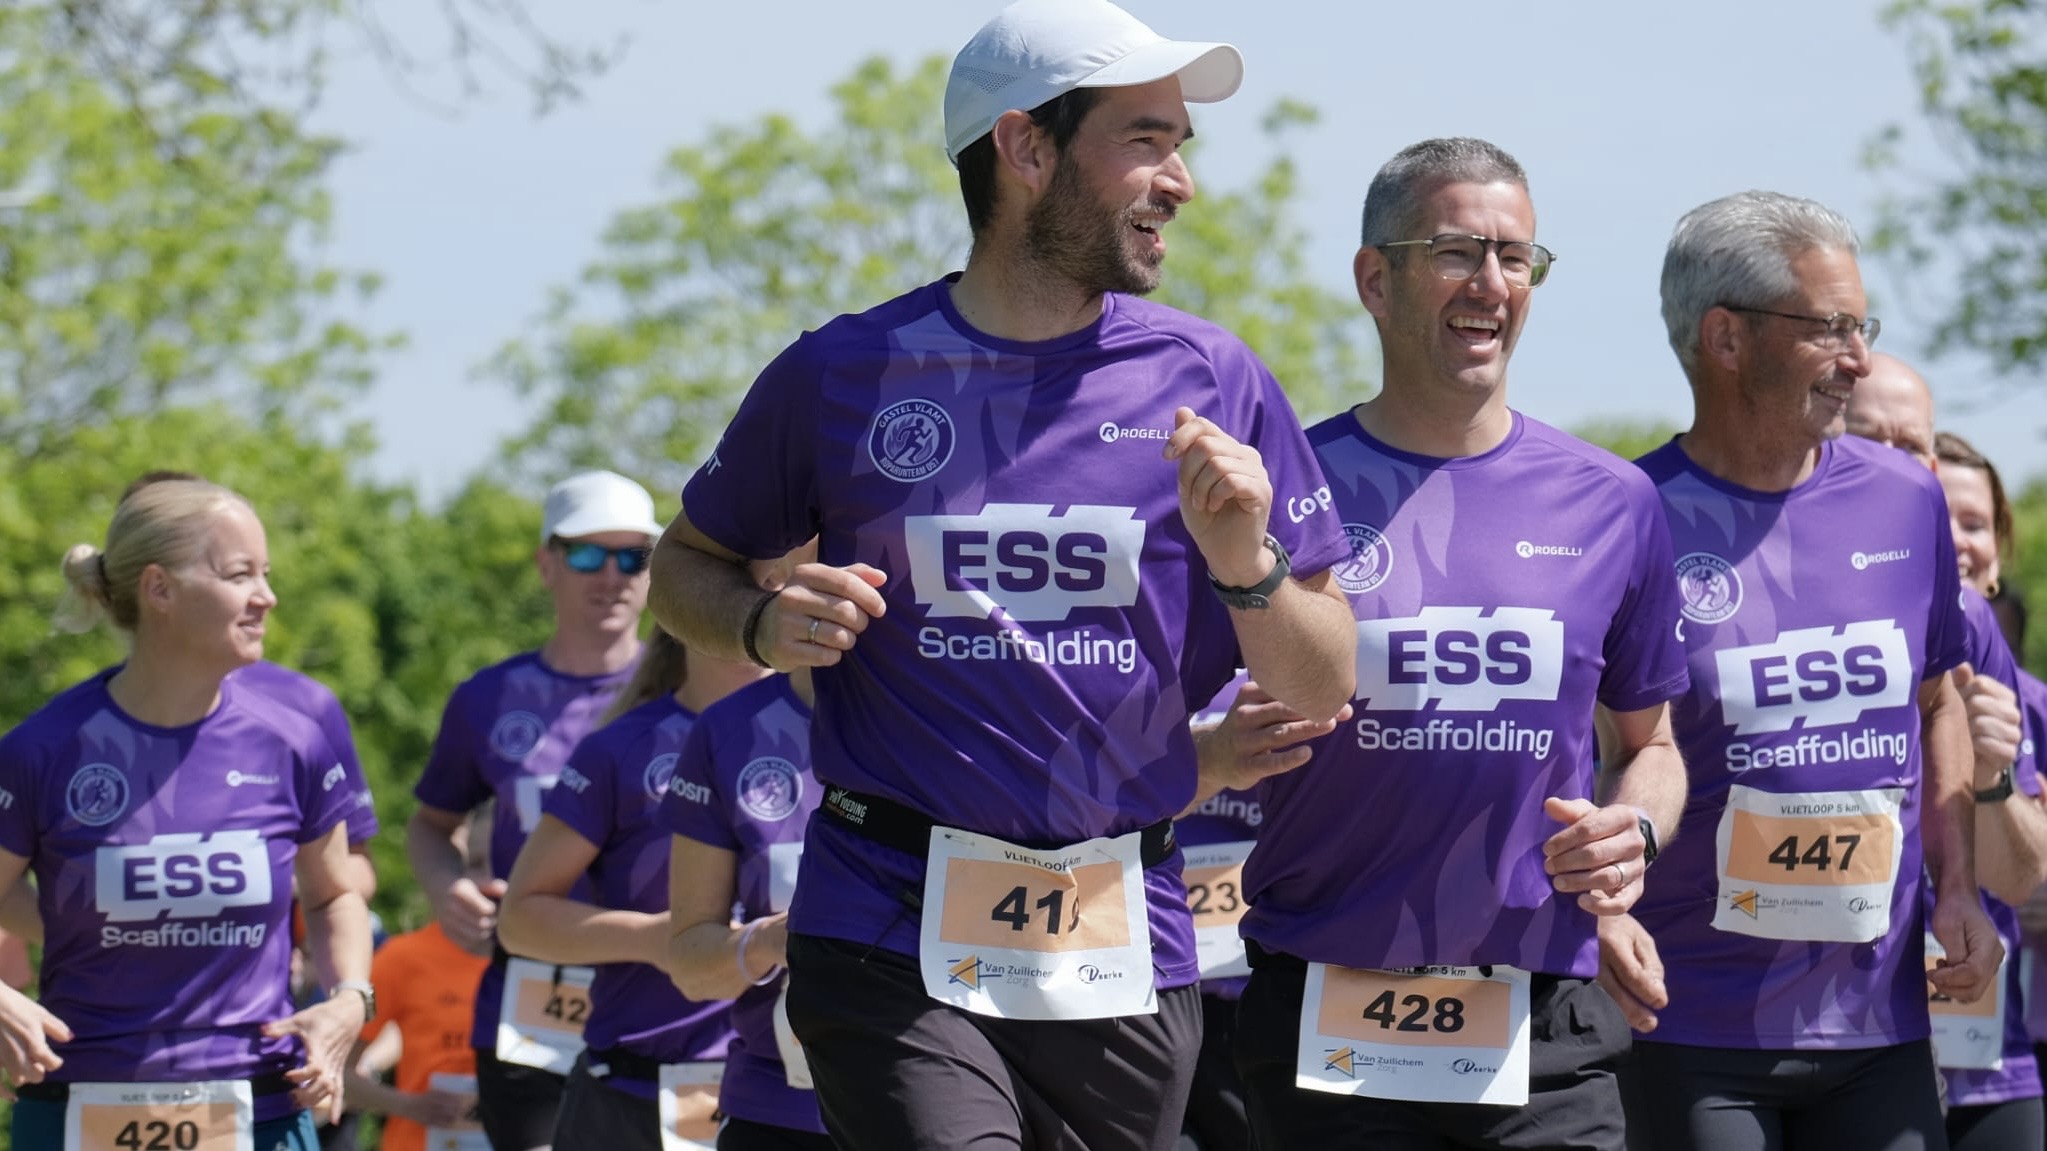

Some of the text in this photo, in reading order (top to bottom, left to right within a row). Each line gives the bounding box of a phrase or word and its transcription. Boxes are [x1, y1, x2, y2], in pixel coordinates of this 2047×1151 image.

[878, 403, 946, 428] GASTEL VLAMT
[1120, 428, 1170, 440] ROGELL
[942, 530, 1108, 592] ESS
[1534, 545, 1582, 556] ROGELLI
[1867, 549, 1910, 564] ROGELLI
[917, 626, 1136, 673] Scaffolding
[1387, 629, 1532, 686] ESS
[1749, 644, 1888, 708] ESS
[1357, 719, 1553, 760] Scaffolding
[1725, 728, 1907, 773] Scaffolding
[1193, 795, 1264, 827] ding
[1780, 804, 1860, 815] VLIETLOOP 5 km
[1768, 834, 1861, 872] 447
[124, 852, 247, 901] ESS
[100, 920, 267, 949] Scaffolding
[985, 963, 1005, 974] Van
[1006, 976, 1029, 988] Zorg
[1451, 965, 1467, 977] km
[1363, 990, 1465, 1033] 428
[1358, 1053, 1424, 1067] Van Zuilichem
[115, 1120, 199, 1151] 420
